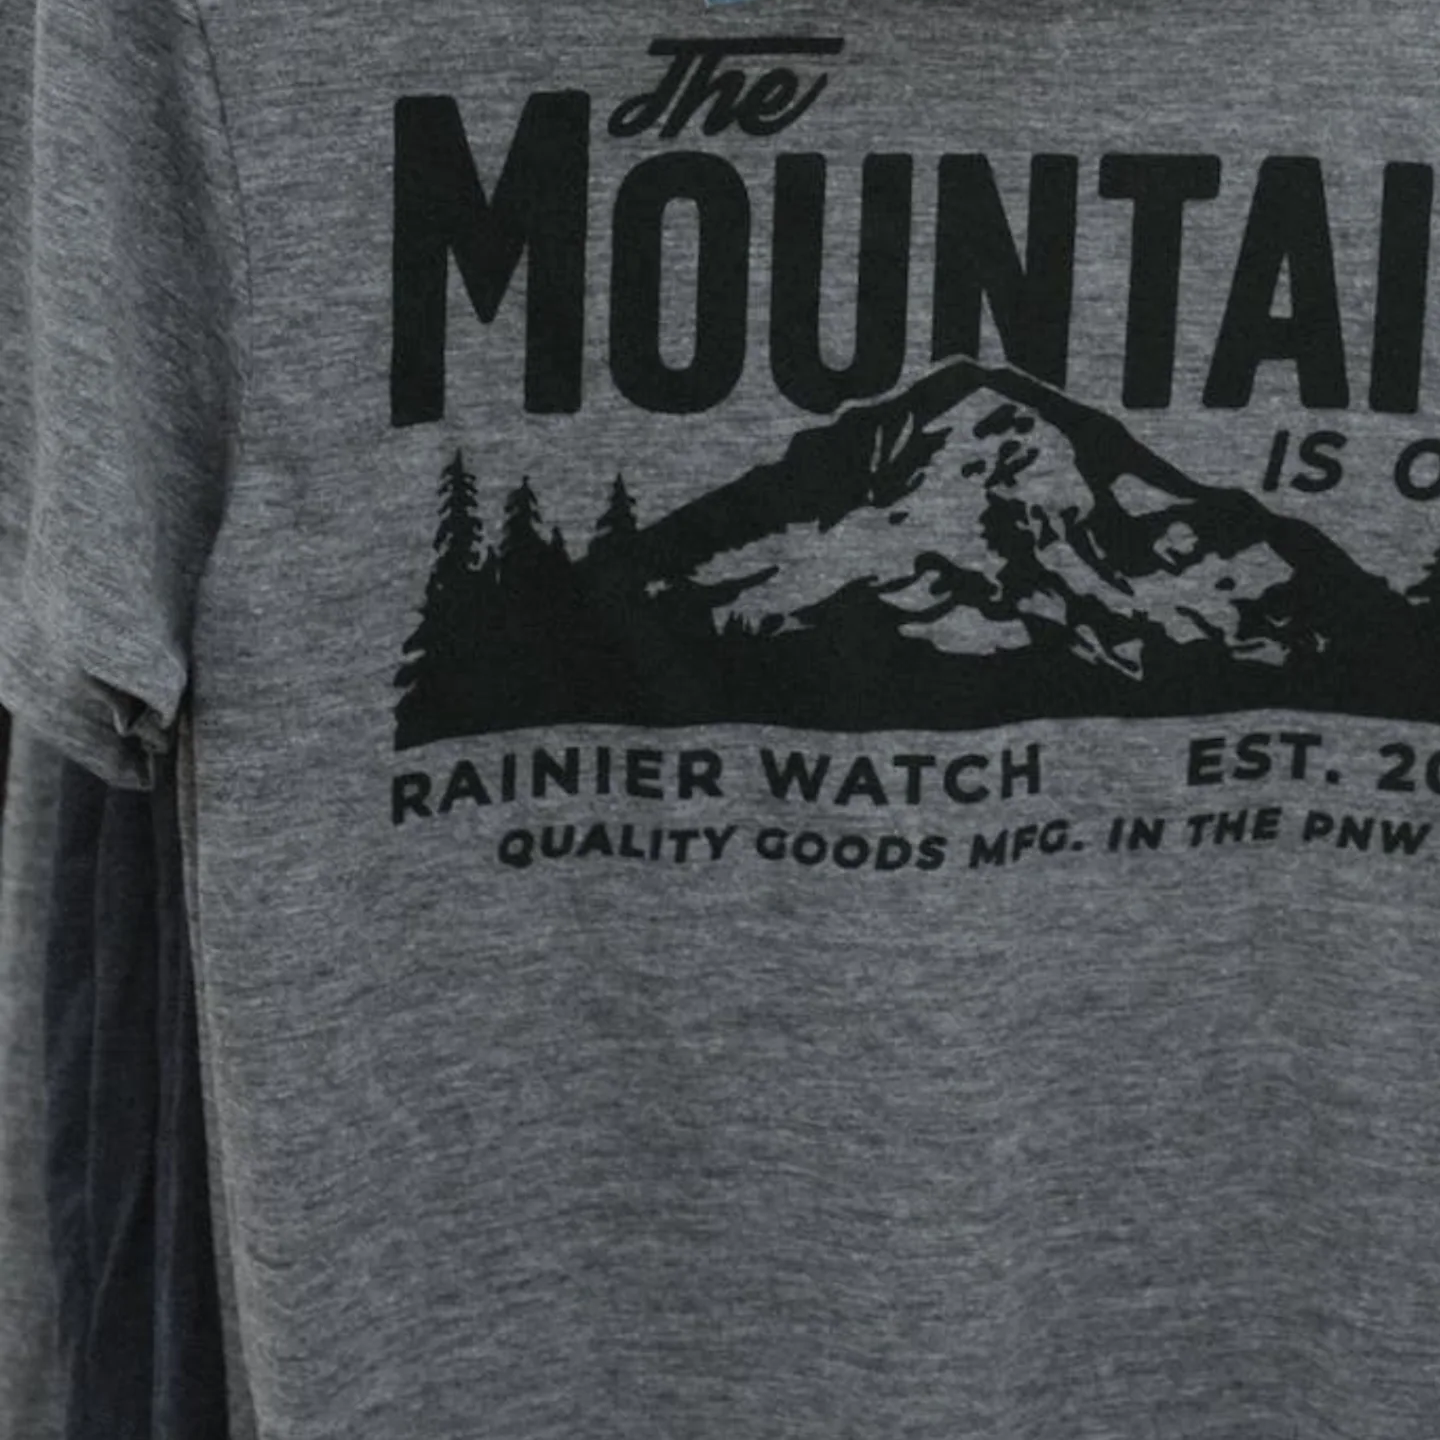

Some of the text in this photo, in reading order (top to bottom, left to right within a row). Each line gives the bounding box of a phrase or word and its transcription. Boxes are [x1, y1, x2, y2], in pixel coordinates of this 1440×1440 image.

[606, 37, 845, 140] The
[1261, 430, 1345, 494] IS
[389, 747, 724, 827] RAINIER
[760, 743, 1045, 806] WATCH
[1185, 733, 1341, 790] EST.
[497, 808, 1433, 871] QUALITY GOODS MFG. IN THE PNW
